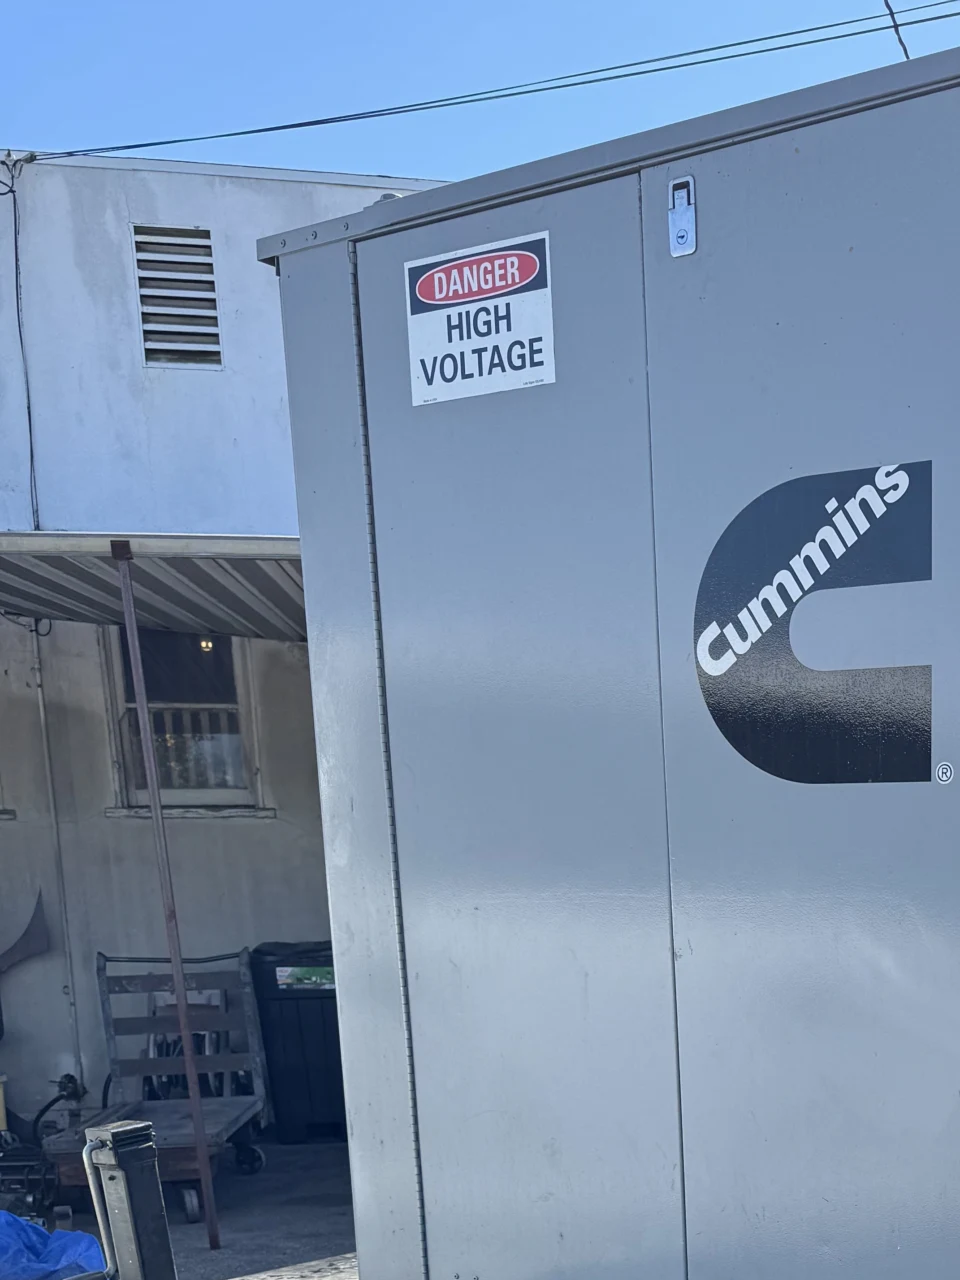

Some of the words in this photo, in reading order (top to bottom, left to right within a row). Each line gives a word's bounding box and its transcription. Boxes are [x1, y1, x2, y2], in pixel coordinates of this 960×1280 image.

[433, 256, 520, 300] DANGER
[446, 302, 512, 343] HIGH
[420, 336, 544, 386] VOLTAGE
[696, 463, 910, 676] Cummins
